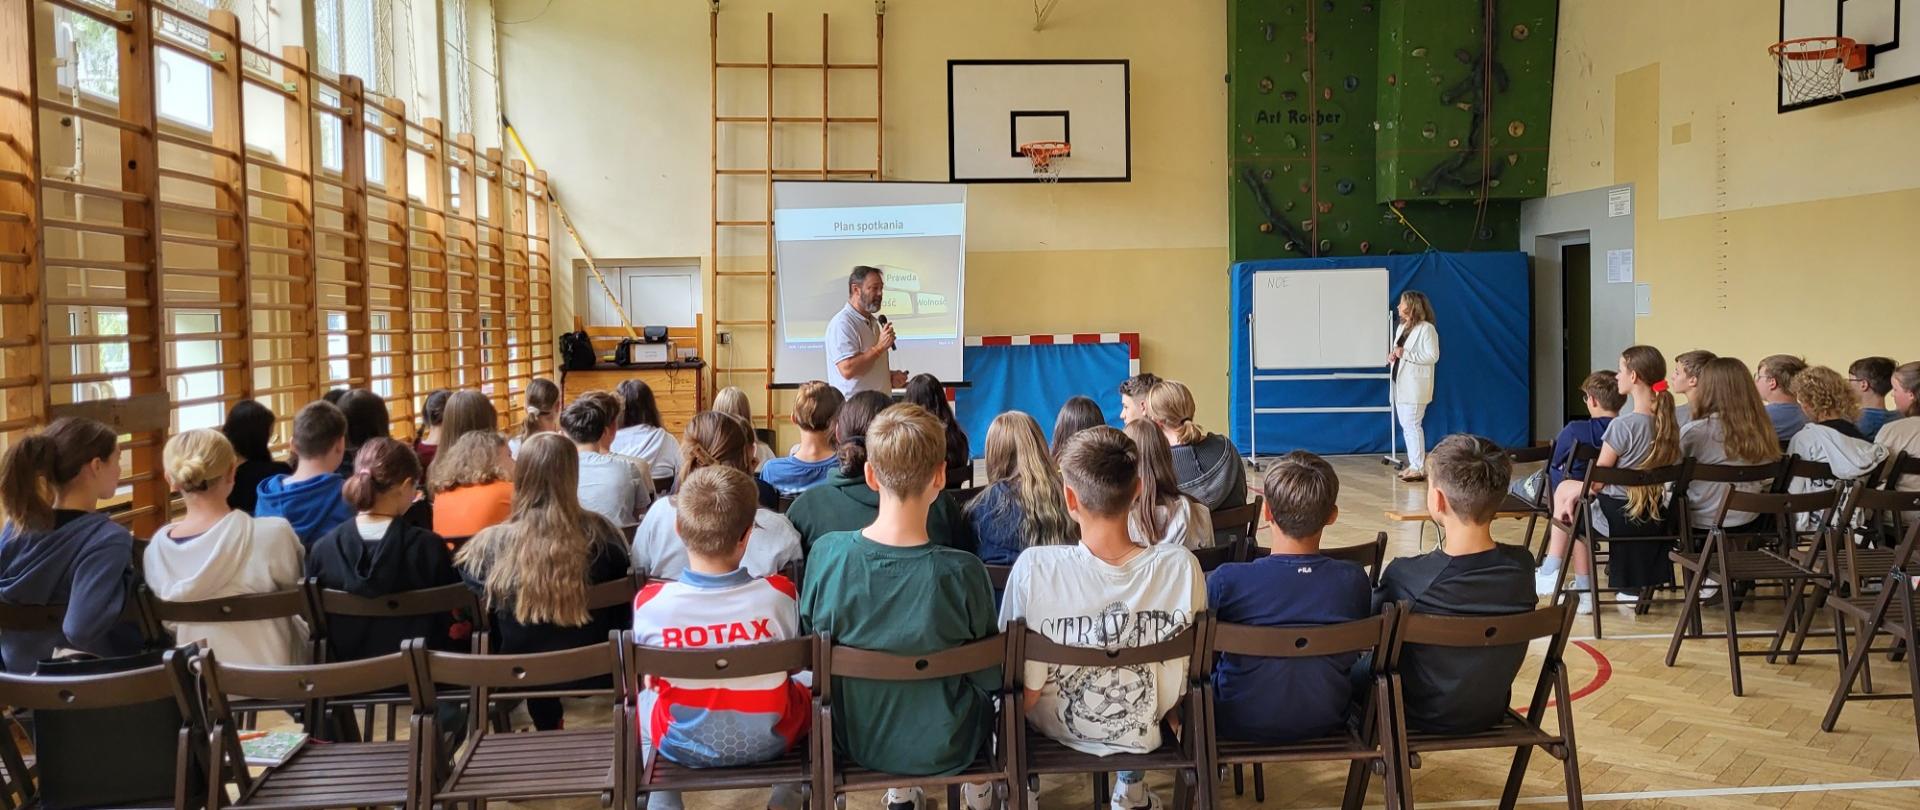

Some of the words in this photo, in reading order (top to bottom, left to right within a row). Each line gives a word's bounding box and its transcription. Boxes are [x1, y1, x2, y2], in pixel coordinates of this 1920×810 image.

[1257, 109, 1281, 124] Art
[834, 221, 855, 232] Plan
[856, 220, 904, 232] spotkania
[886, 273, 917, 282] Prawda
[662, 618, 772, 649] ROTAX
